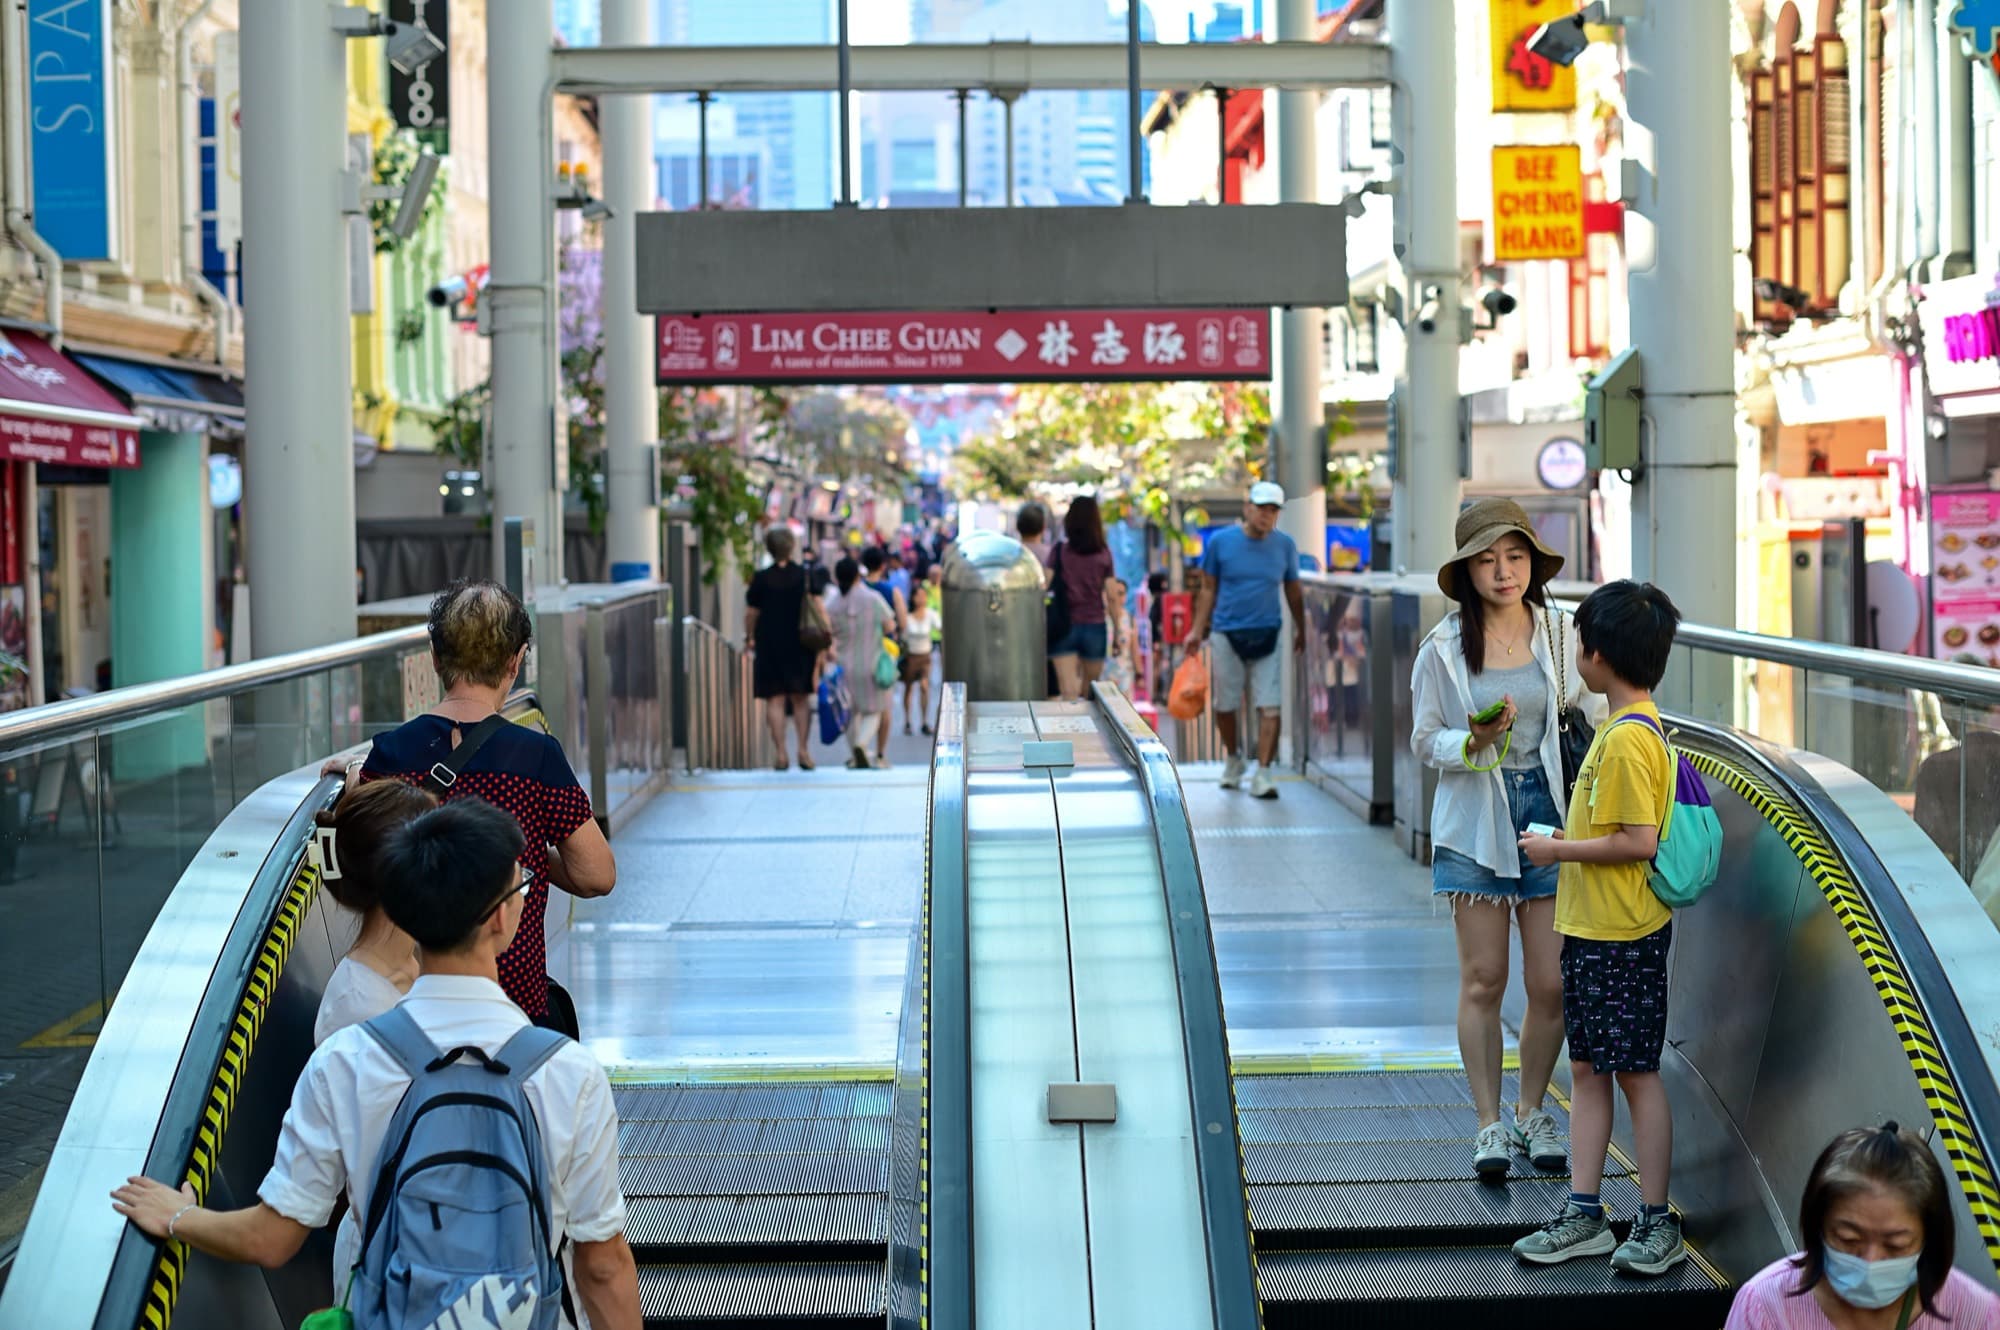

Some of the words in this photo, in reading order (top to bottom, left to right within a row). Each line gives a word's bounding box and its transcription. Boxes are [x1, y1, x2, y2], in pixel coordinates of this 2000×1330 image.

[33, 0, 94, 133] SPA
[1515, 155, 1558, 182] BEE
[1499, 191, 1577, 217] CHENG
[1501, 225, 1576, 251] HIANG
[752, 323, 805, 352] LIM
[812, 322, 892, 352] CHEE
[899, 321, 982, 351] GUAN
[1036, 318, 1188, 367] 林志源
[771, 354, 784, 369] A
[815, 353, 831, 368] of
